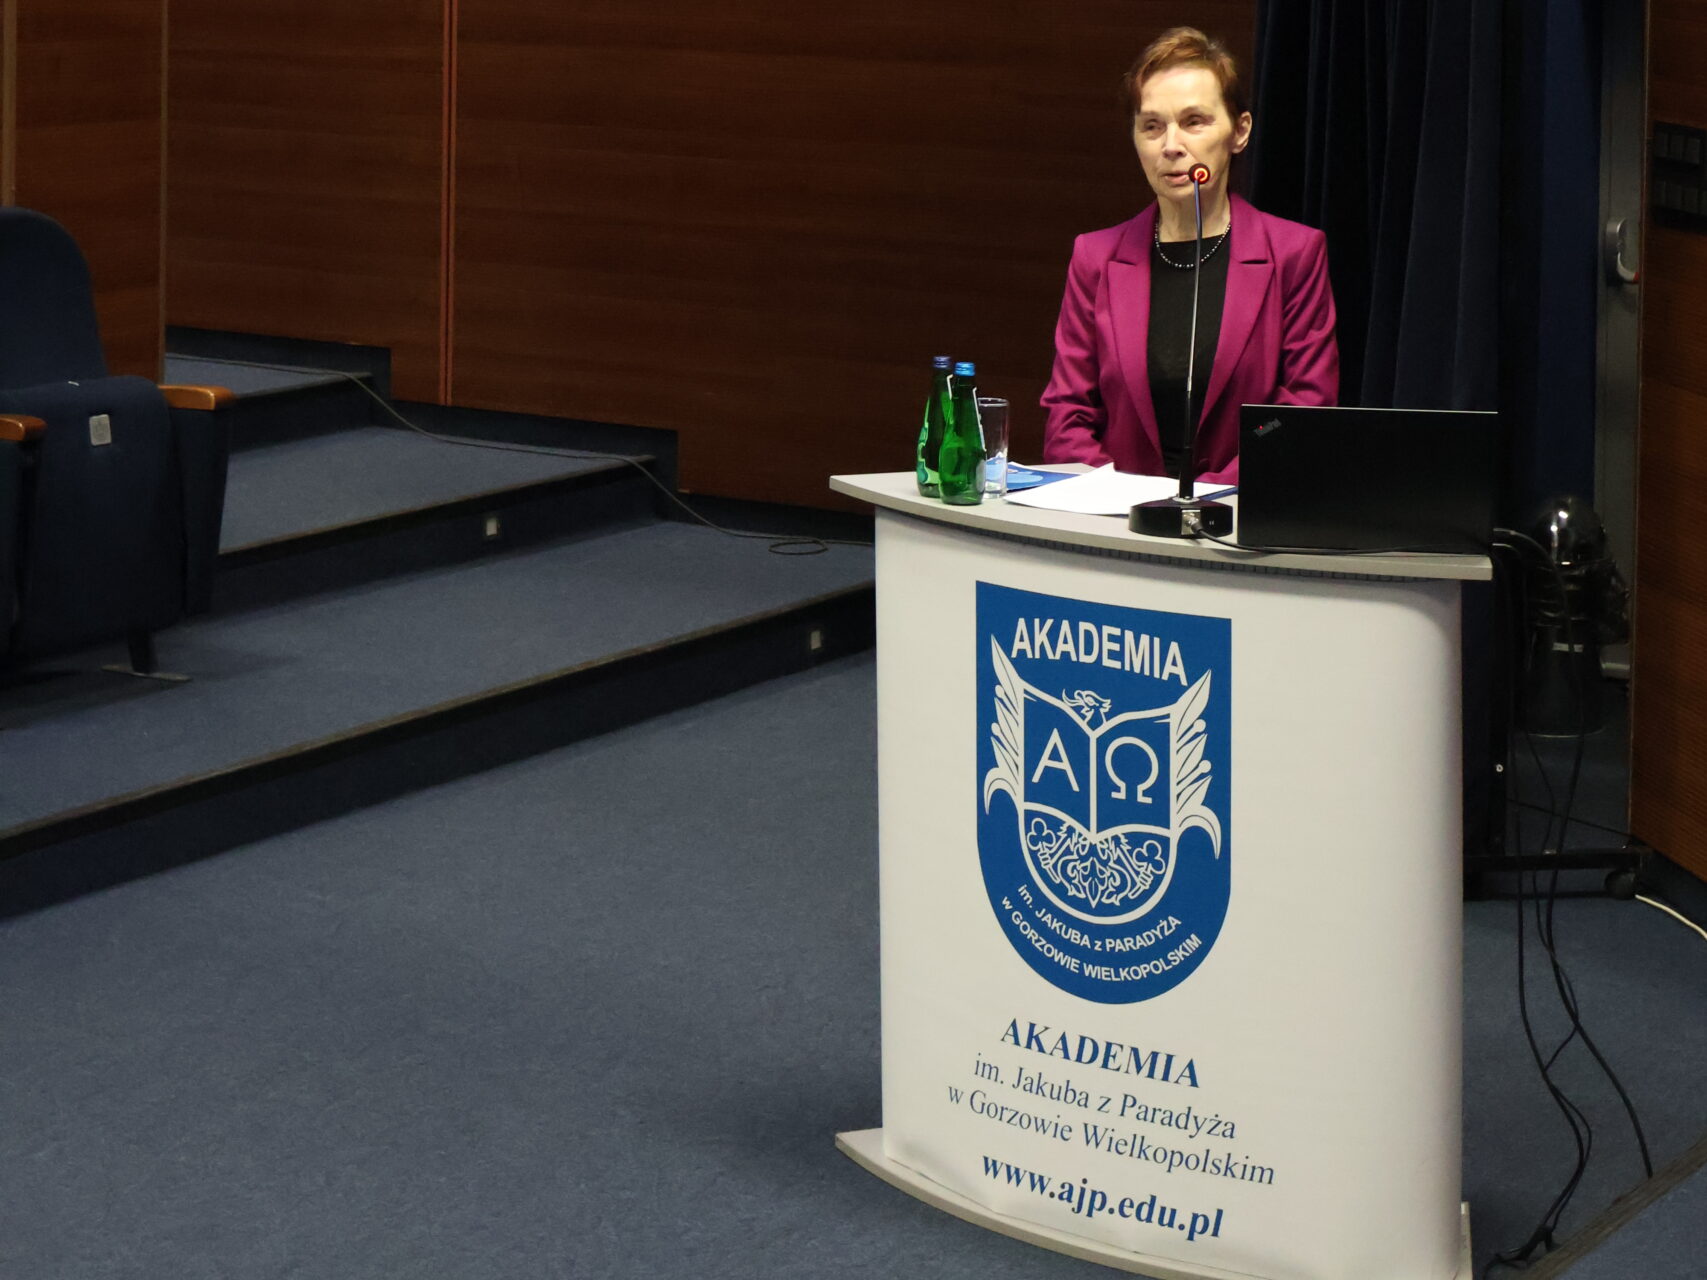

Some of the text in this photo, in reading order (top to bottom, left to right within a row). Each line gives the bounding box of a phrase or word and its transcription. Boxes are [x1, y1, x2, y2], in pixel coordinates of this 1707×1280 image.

[1011, 617, 1189, 687] AKADEMIA
[1002, 896, 1202, 982] w GORZOWIE WIELKOPOLSKIM
[1017, 883, 1182, 952] im. JAKUBA z PARADYŻA
[973, 1052, 1236, 1139] im. Jakuba z Paradyża
[1000, 1017, 1201, 1088] AKADEMIA
[948, 1086, 1276, 1185] w Gorzowie Wielkopolskim
[982, 1154, 1225, 1242] www.ajp.edu.pl
